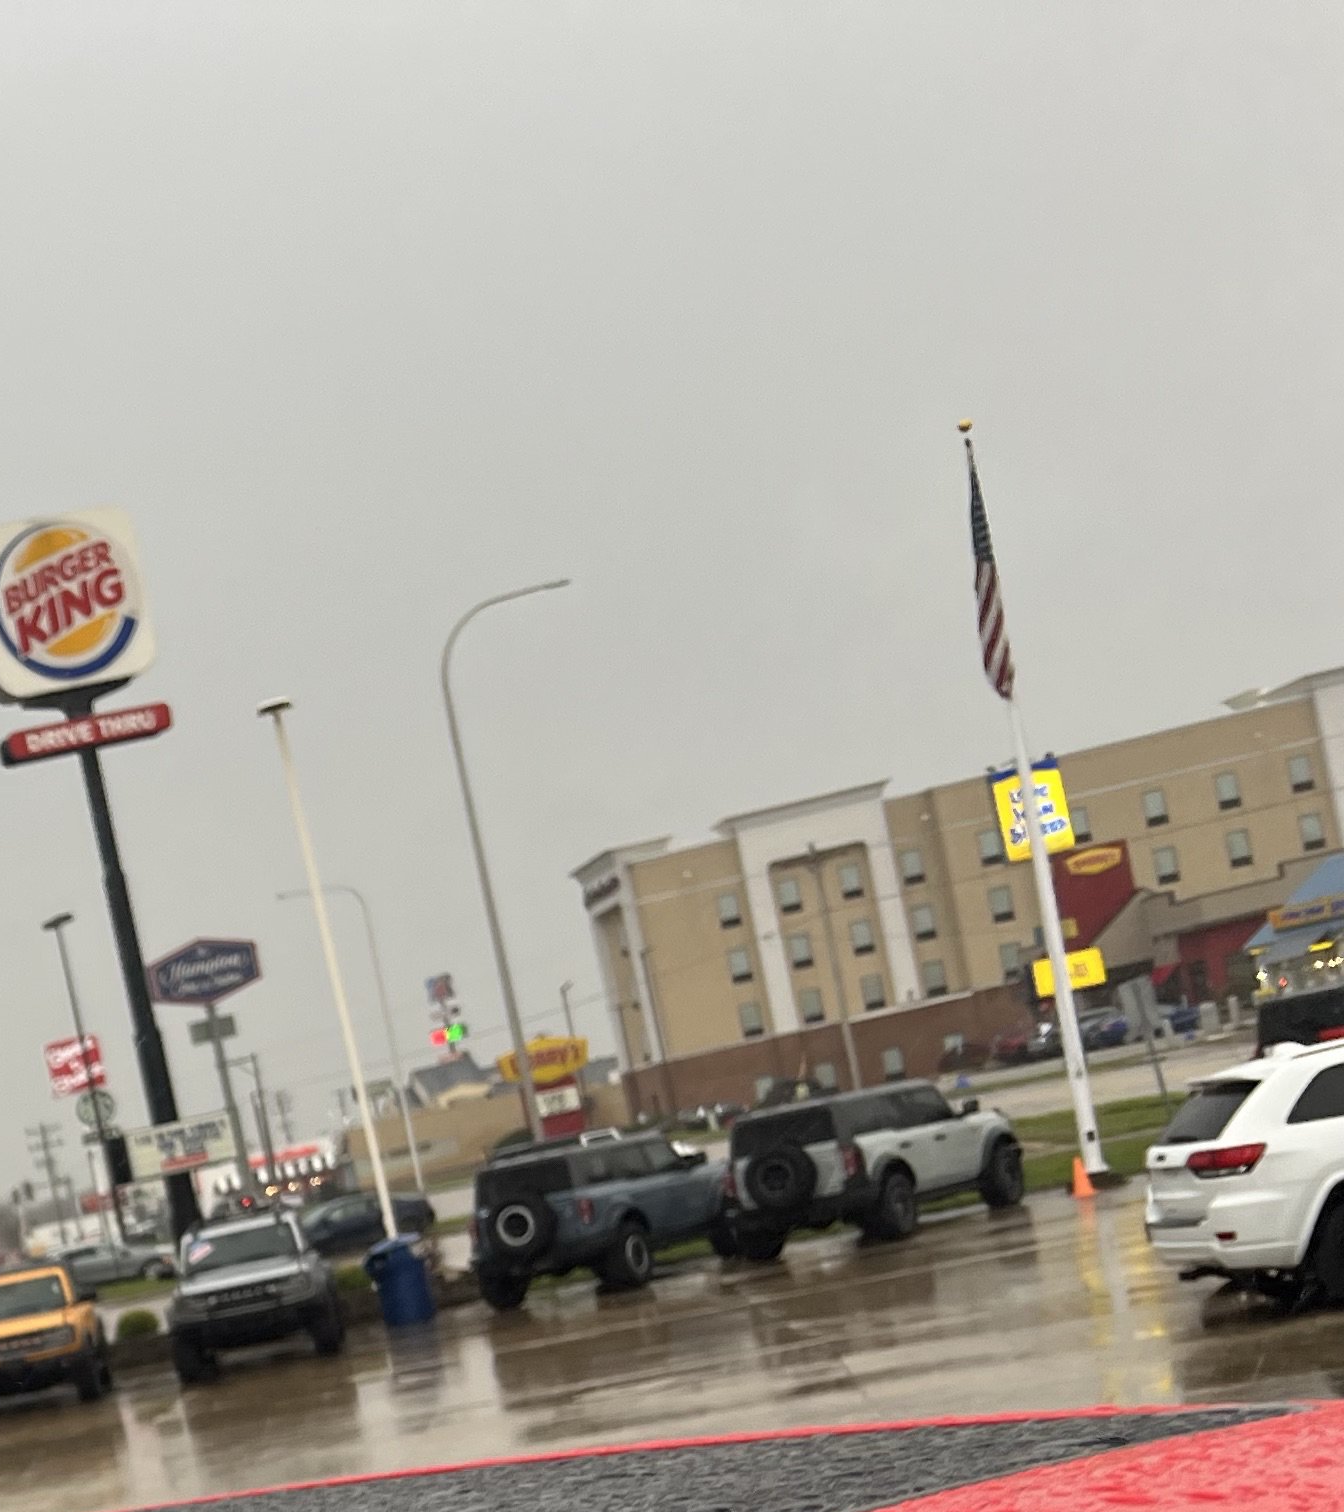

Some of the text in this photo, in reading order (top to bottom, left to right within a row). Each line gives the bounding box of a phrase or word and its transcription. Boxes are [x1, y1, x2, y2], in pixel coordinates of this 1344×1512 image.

[4, 541, 114, 615] BURGER
[15, 568, 124, 655] KING
[25, 720, 94, 752] DRIVE
